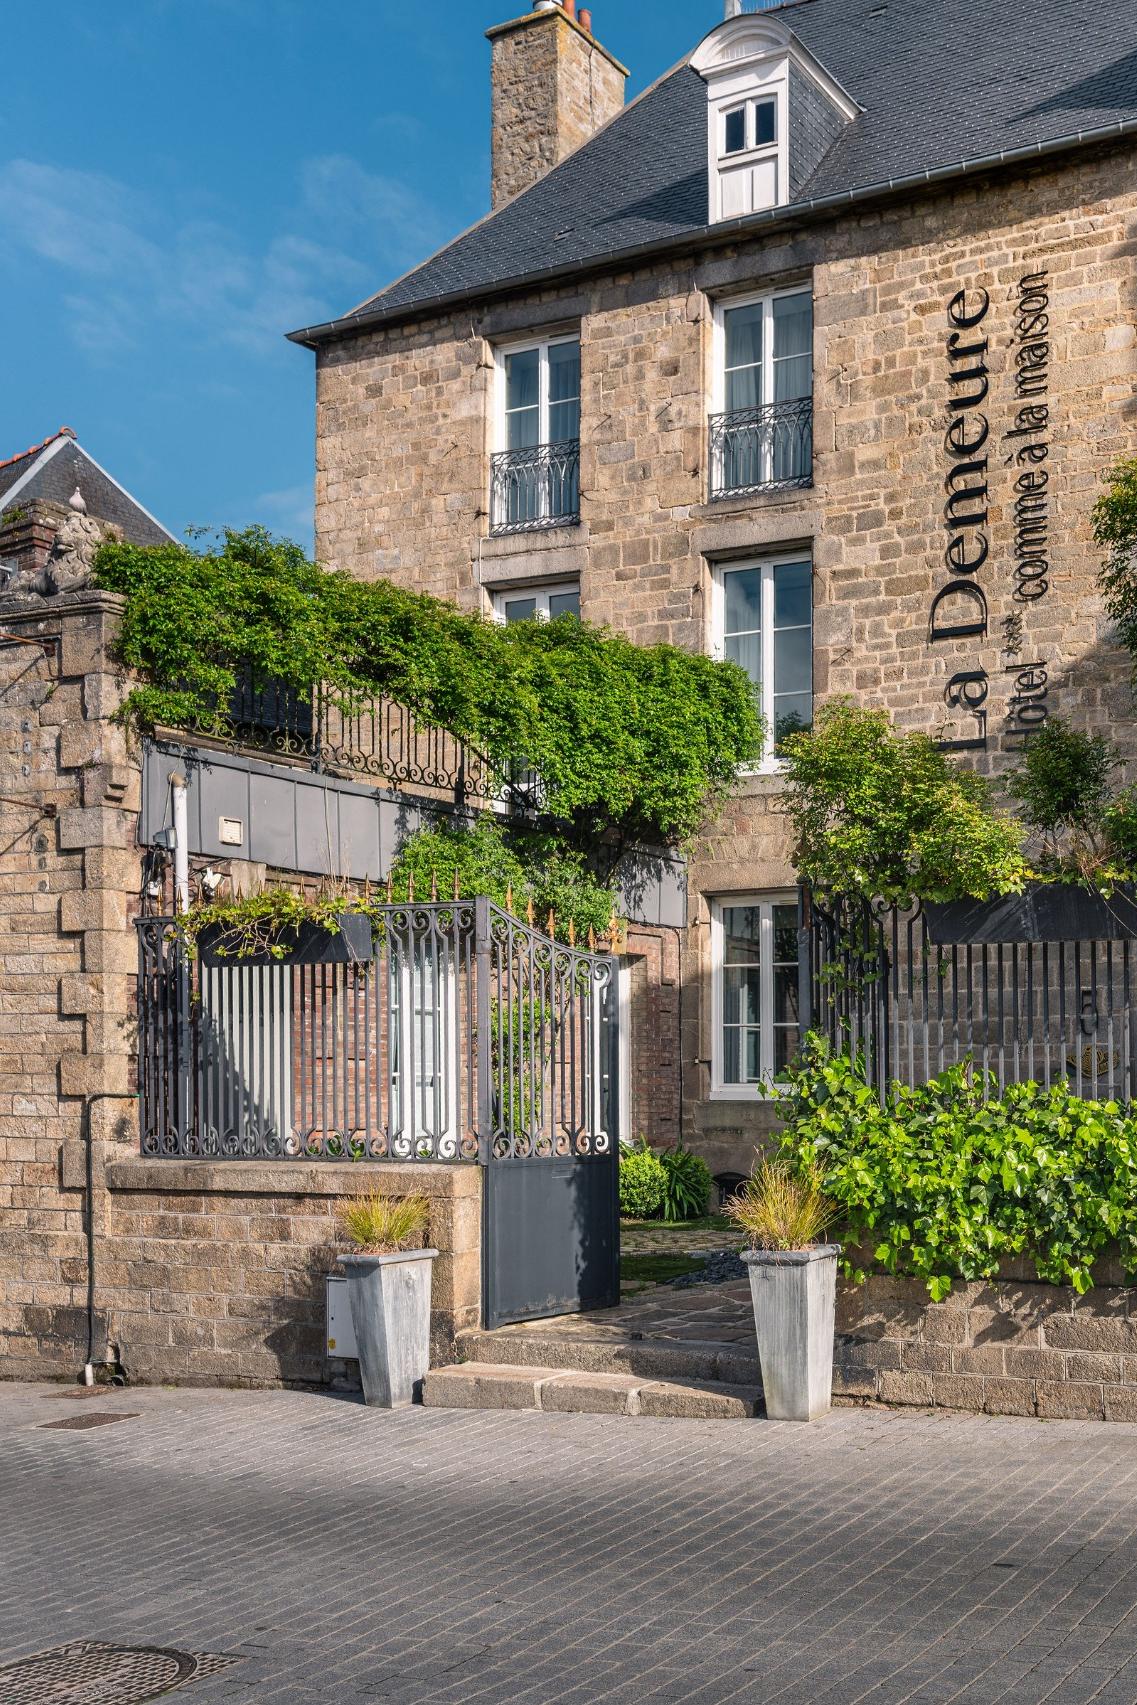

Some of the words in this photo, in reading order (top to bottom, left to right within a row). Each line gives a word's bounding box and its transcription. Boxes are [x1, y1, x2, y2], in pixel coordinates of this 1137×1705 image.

[1010, 270, 1048, 394] maison
[931, 286, 988, 643] Demeure
[1006, 404, 1048, 435] la
[1006, 442, 1048, 463] à
[1017, 470, 1048, 599] comme
[934, 656, 988, 752] La
